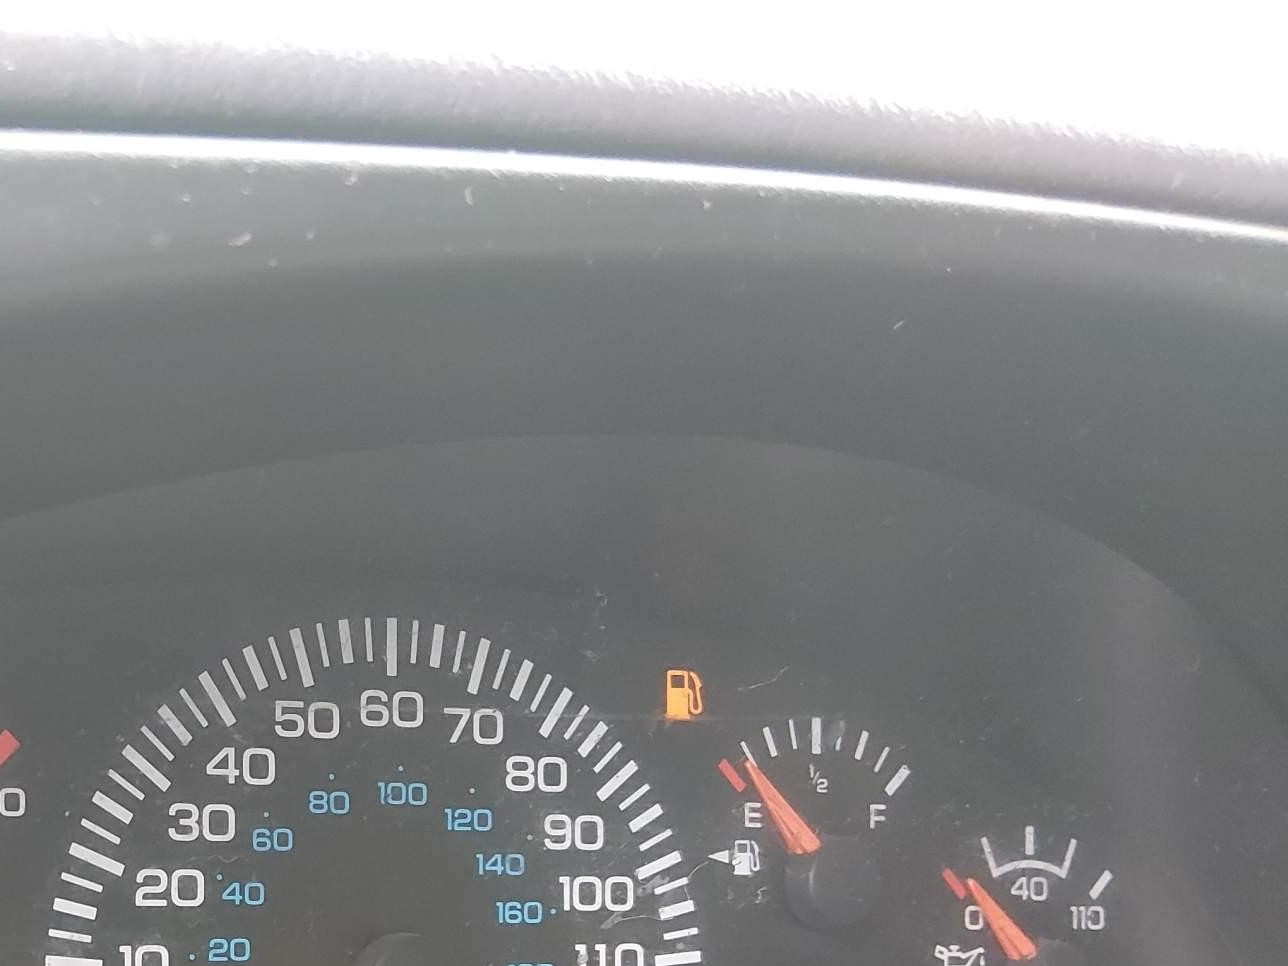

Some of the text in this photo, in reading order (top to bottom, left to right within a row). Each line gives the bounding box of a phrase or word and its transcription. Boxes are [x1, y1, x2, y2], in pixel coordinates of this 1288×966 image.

[274, 700, 340, 740] 50
[360, 689, 424, 729] 60
[443, 706, 504, 745] 70
[205, 747, 276, 785] 40
[505, 755, 567, 793] 80
[308, 790, 351, 814] 80
[378, 781, 428, 806] 100
[167, 803, 236, 843] 30
[444, 808, 493, 832] 120
[744, 802, 763, 828] E
[869, 803, 887, 829] F
[252, 827, 294, 852] 60
[543, 814, 605, 852] 90
[475, 853, 525, 876] 140
[134, 868, 205, 908] 20
[221, 881, 265, 906] 40
[558, 876, 634, 912] 100
[1010, 877, 1049, 901] 40
[496, 901, 543, 924] 160
[964, 905, 984, 930] 0
[1070, 906, 1105, 930] 110
[208, 938, 251, 962] 20
